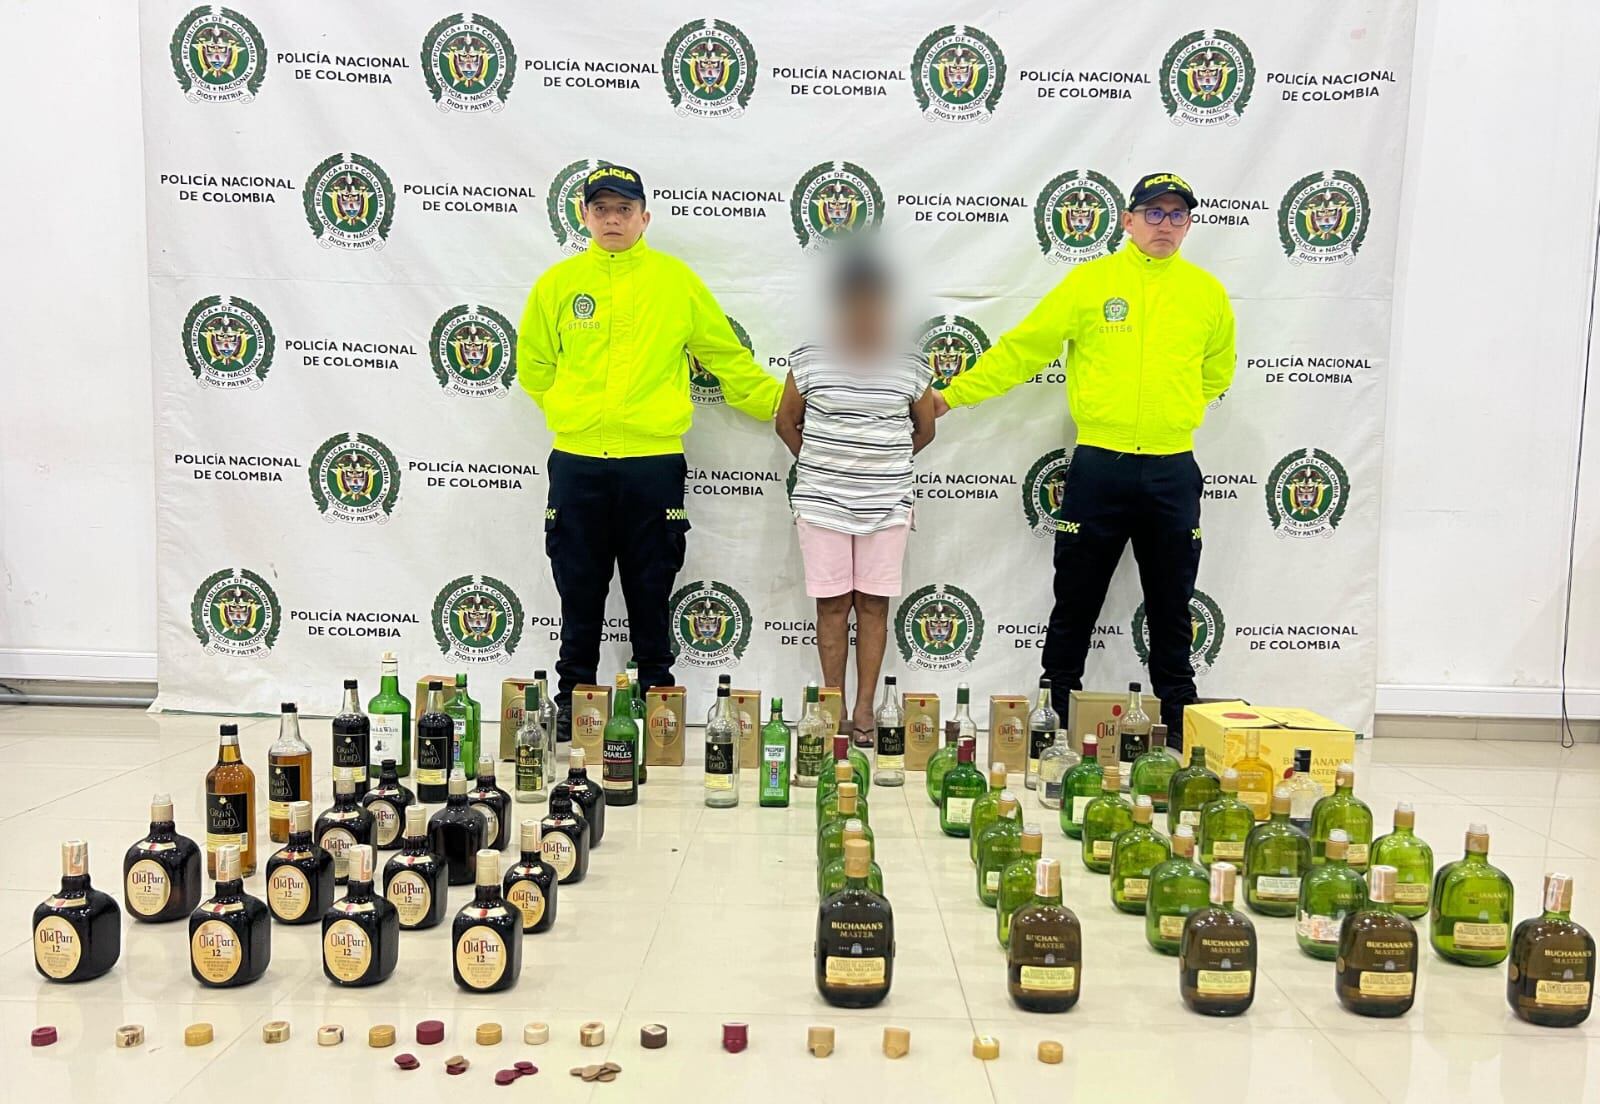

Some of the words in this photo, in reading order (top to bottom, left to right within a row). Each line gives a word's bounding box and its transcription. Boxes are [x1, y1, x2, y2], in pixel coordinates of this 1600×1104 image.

[277, 51, 331, 64] POLICÍA
[336, 56, 409, 68] NACIONAL
[974, 41, 995, 79] COLOMBIA
[525, 58, 580, 71] POLICÍA
[585, 62, 659, 74] NACIONAL
[295, 69, 311, 79] DE
[315, 70, 392, 84] COLOMBIA
[773, 66, 827, 79] POLICÍA
[832, 70, 905, 80] NACIONAL
[1020, 69, 1075, 82] POLICÍA
[1079, 72, 1151, 83] NACIONAL
[1267, 73, 1318, 85] POLICÍA
[1322, 71, 1396, 85] NACIONAL
[544, 77, 561, 87] DE
[565, 77, 640, 89] COLOMBIA
[791, 85, 808, 94] DE
[813, 85, 887, 96] COLOMBIA
[1038, 88, 1055, 98] DE
[1059, 88, 1132, 99] COLOMBIA
[1282, 90, 1298, 101] DE
[1302, 87, 1379, 101] COLOMBIA
[958, 89, 991, 110] NACIONAL
[958, 110, 981, 120] PATRIA
[161, 174, 218, 186] POLICÍA
[222, 176, 295, 189] NACIONAL
[404, 183, 459, 196] POLICÍA
[463, 186, 536, 197] NACIONAL
[654, 187, 708, 200] POLICÍA
[712, 191, 785, 202] NACIONAL
[180, 191, 198, 201] DE
[202, 192, 275, 203] COLOMBIA
[898, 193, 951, 206] POLICÍA
[956, 196, 1028, 207] NACIONAL
[423, 201, 440, 211] DE
[445, 202, 518, 213] COLOMBIA
[1200, 198, 1269, 210] NACIONAL
[672, 206, 688, 216] DE
[693, 206, 766, 217] COLOMBIA
[915, 211, 932, 221] DE
[937, 212, 1009, 222] COLOMBIA
[1191, 213, 1249, 226] OLOMBIA
[286, 339, 338, 351] POLICÍA
[343, 342, 417, 355] NACIONAL
[304, 356, 319, 366] DE
[324, 357, 399, 369] COLOMBIA
[1248, 355, 1304, 368] POLICÍA
[1308, 358, 1371, 368] NACIONAL
[1266, 373, 1284, 382] DE
[1288, 373, 1352, 383] COLOMBIA
[175, 453, 226, 465] POLICÍA
[229, 456, 301, 467] NACIONAL
[367, 447, 389, 484] COLOMBIA
[409, 461, 464, 472] POLICÍA
[469, 464, 540, 475] NACIONAL
[194, 470, 211, 479] DE
[215, 471, 283, 481] COLOMBIA
[712, 471, 781, 481] NACIONAL
[946, 475, 1017, 484] NACIONAL
[1202, 475, 1257, 484] CIONAL
[428, 477, 445, 487] DE
[449, 478, 522, 489] COLOMBIA
[693, 485, 763, 496] COLOMBIA
[928, 489, 998, 499] COLOMBIA
[1203, 490, 1238, 499] MBIA
[357, 493, 387, 513] NACIONAL
[357, 512, 380, 521] PATRIA
[291, 609, 342, 621] POLICÍA
[346, 613, 419, 623] NACIONAL
[531, 617, 561, 626] POLI
[764, 619, 816, 631] POLICÍA
[1236, 626, 1284, 636] POLICÍA
[1288, 626, 1358, 635] NACIONAL
[309, 626, 324, 635] DE
[328, 627, 401, 637] COLOMBIA
[781, 636, 798, 645] DE
[1014, 640, 1032, 649] DE
[1250, 641, 1266, 650] DE
[1269, 641, 1340, 650] COLOMBIA
[1097, 721, 1115, 739] Old
[607, 744, 625, 752] KING
[604, 750, 632, 759] CHARLES
[132, 872, 146, 884] Old
[273, 877, 287, 890] Old
[393, 882, 407, 895] Old
[404, 896, 412, 904] 12
[831, 922, 883, 931] BUCHANAN'S
[40, 930, 54, 944] Old
[200, 935, 214, 948] Old
[331, 934, 345, 947] Old
[343, 948, 352, 956] 12
[463, 940, 478, 953] Old
[212, 949, 221, 957] 12
[476, 955, 485, 963] 12
